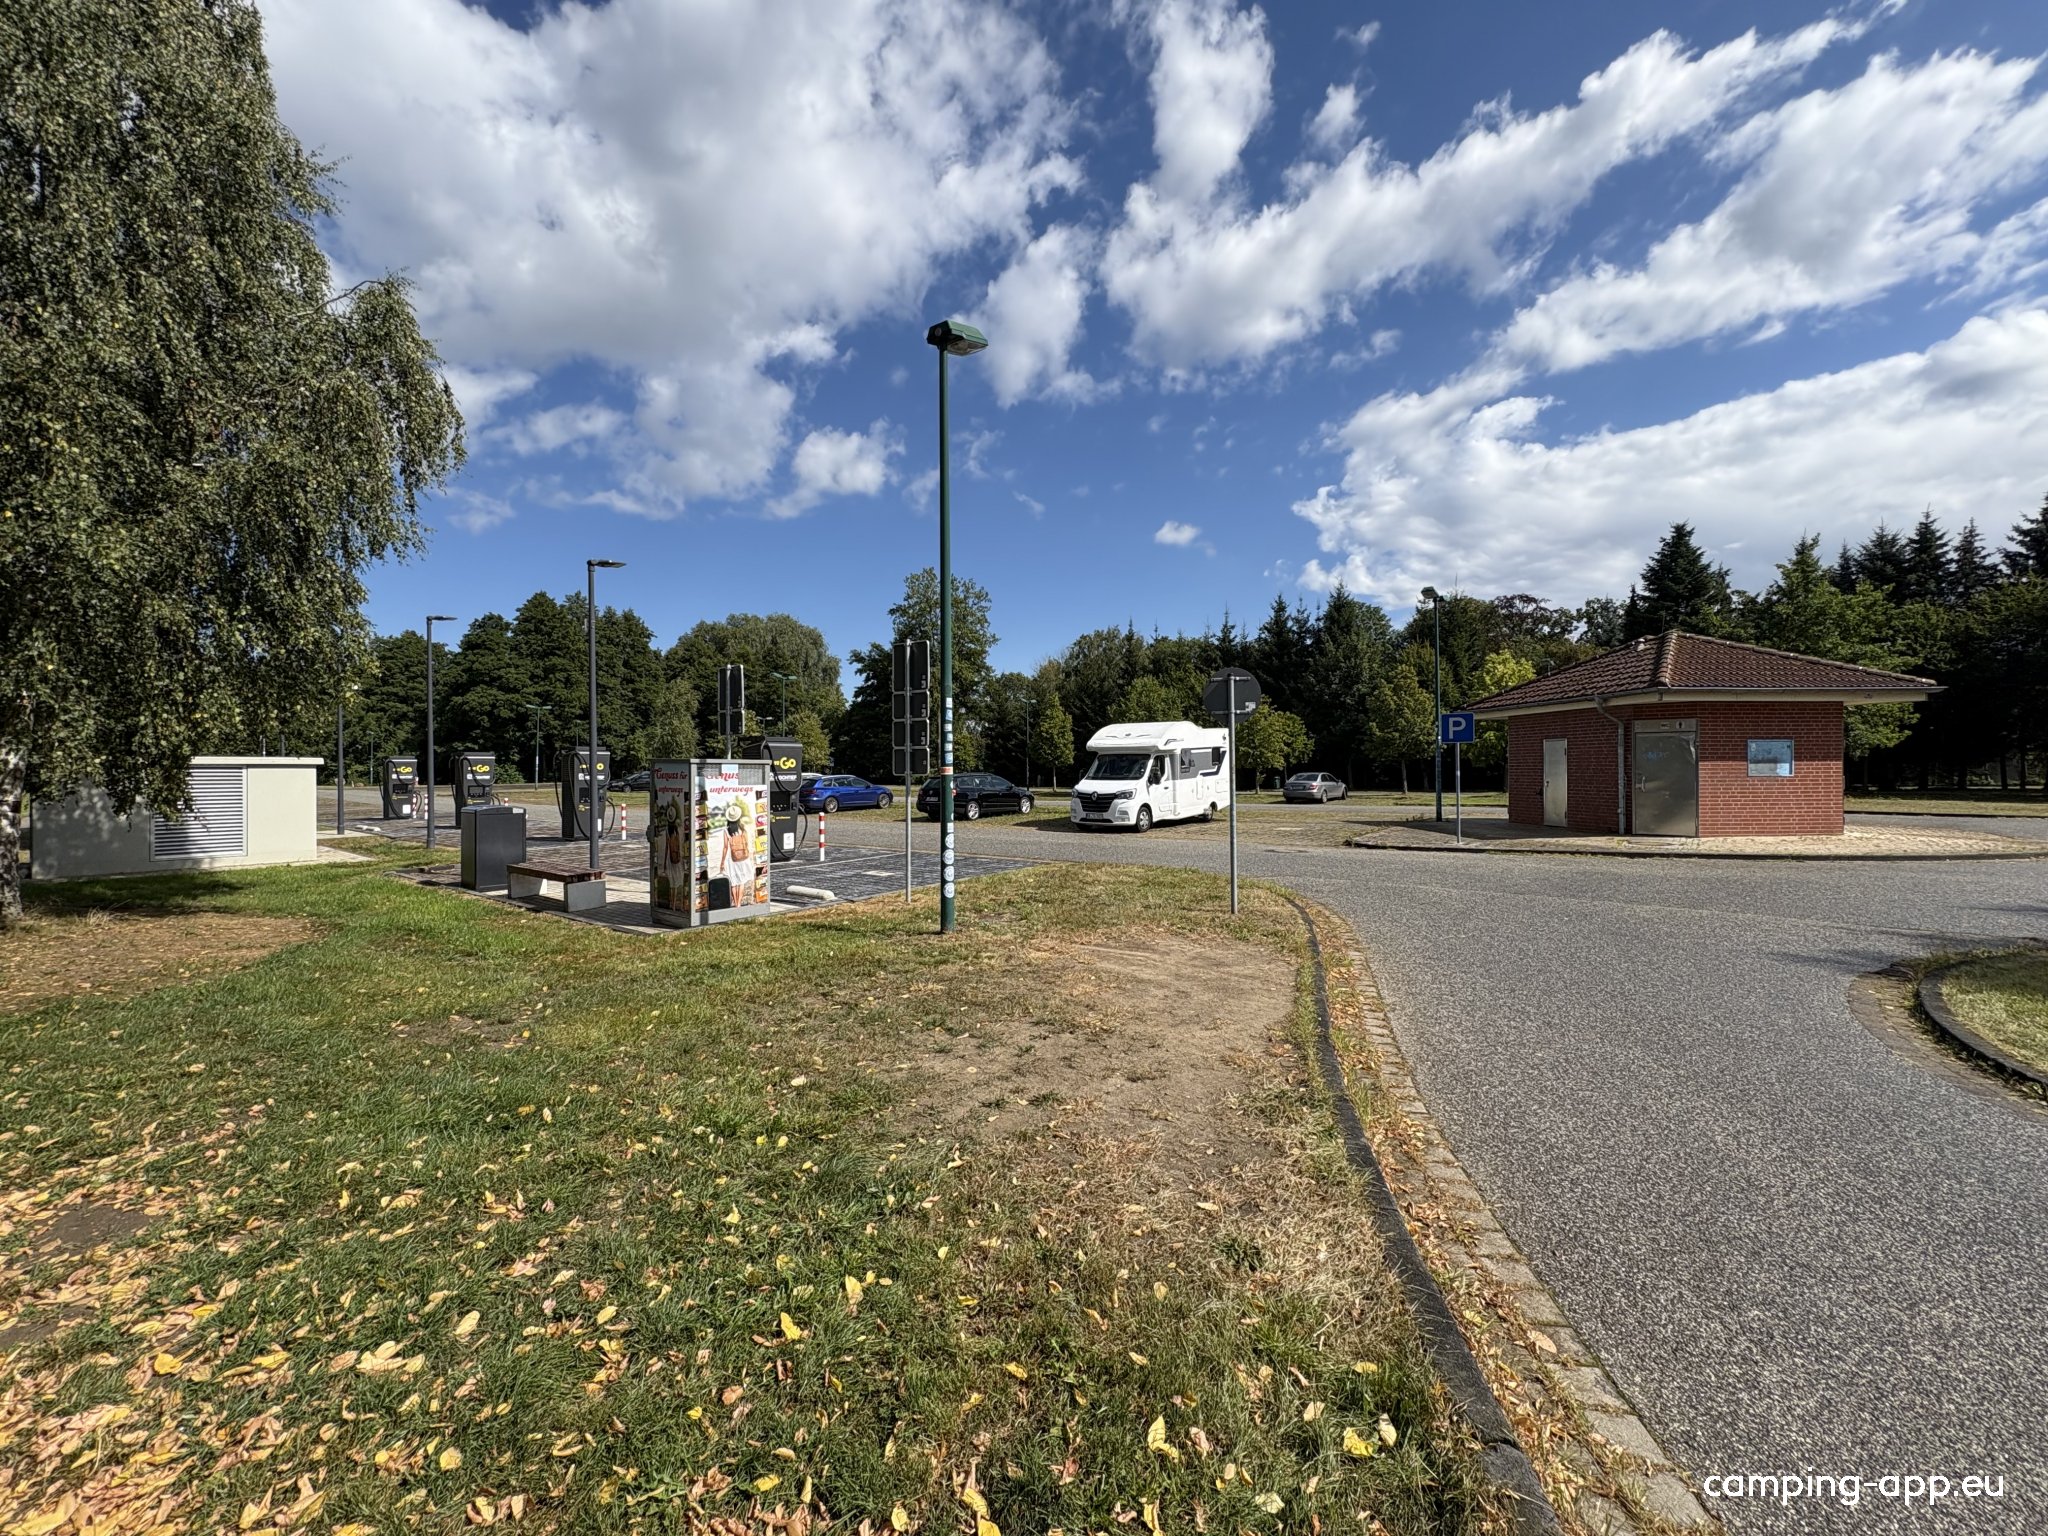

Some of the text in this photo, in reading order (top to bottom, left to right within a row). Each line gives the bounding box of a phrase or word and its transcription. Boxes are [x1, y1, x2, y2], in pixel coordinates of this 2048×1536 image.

[1448, 716, 1467, 739] P
[476, 764, 490, 773] Go
[780, 757, 796, 769] Go
[709, 785, 754, 796] unterwegs
